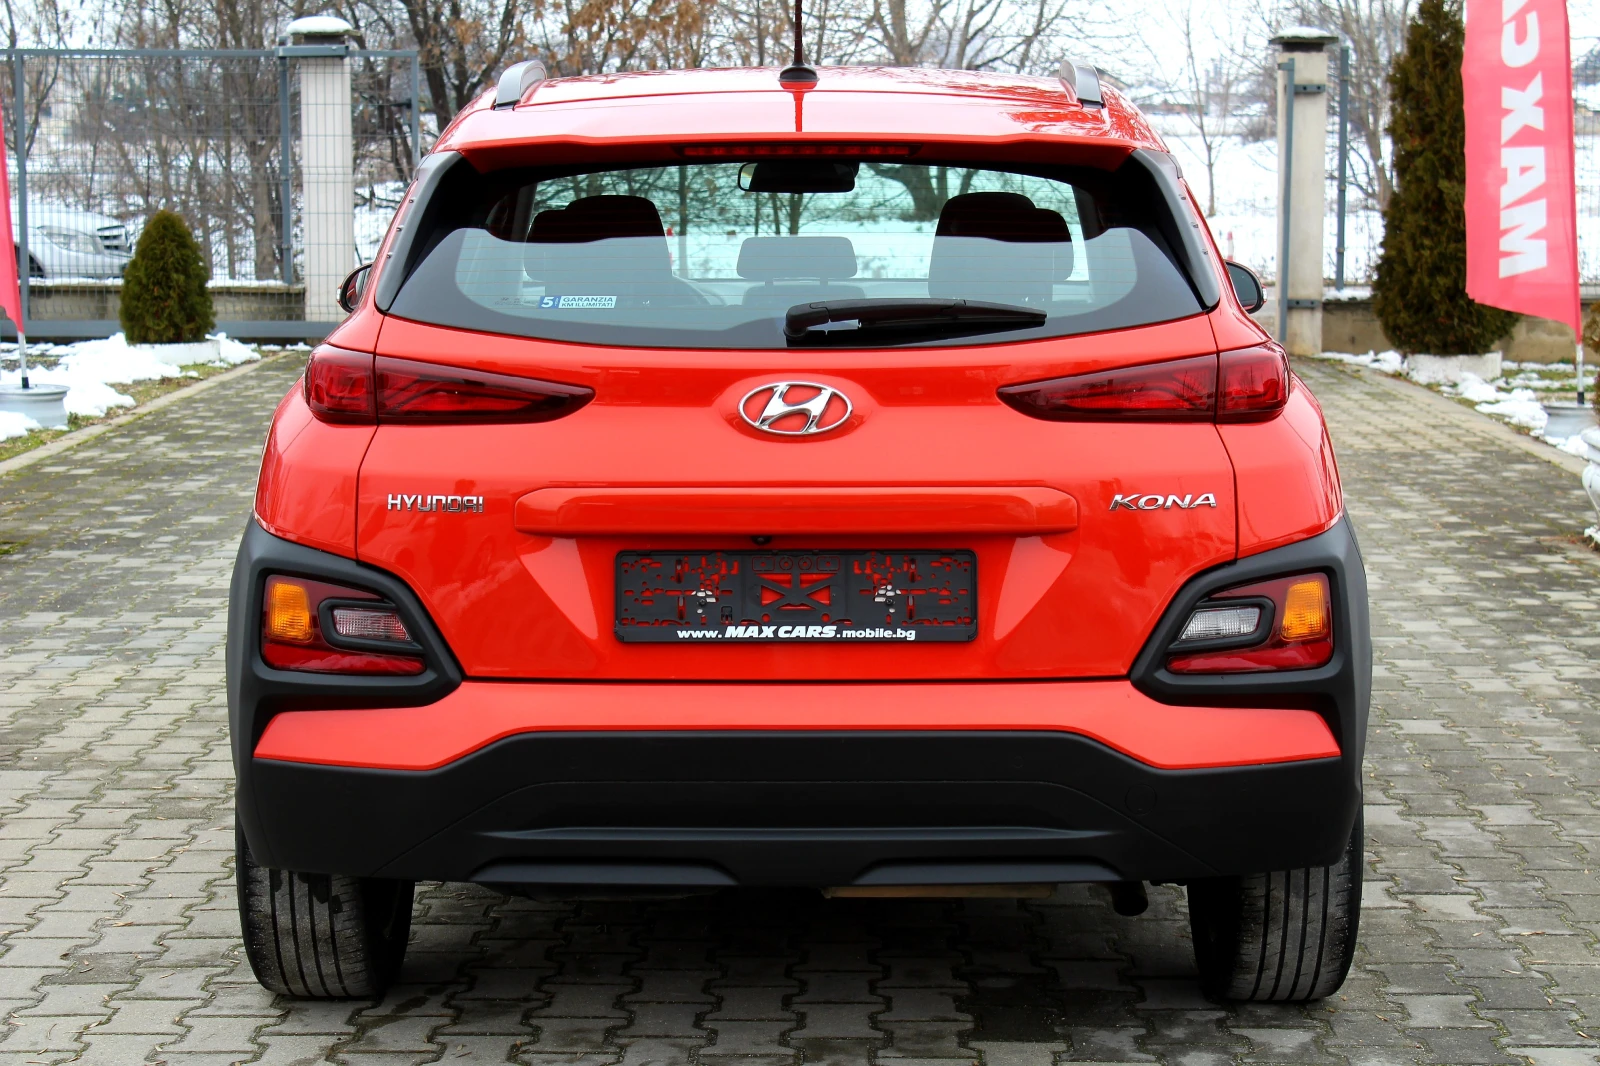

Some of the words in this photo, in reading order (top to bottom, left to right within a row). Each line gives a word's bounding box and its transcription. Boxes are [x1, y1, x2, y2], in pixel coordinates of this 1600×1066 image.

[541, 296, 554, 308] 5
[387, 493, 484, 513] HYUNDAI
[1108, 493, 1217, 510] KONA
